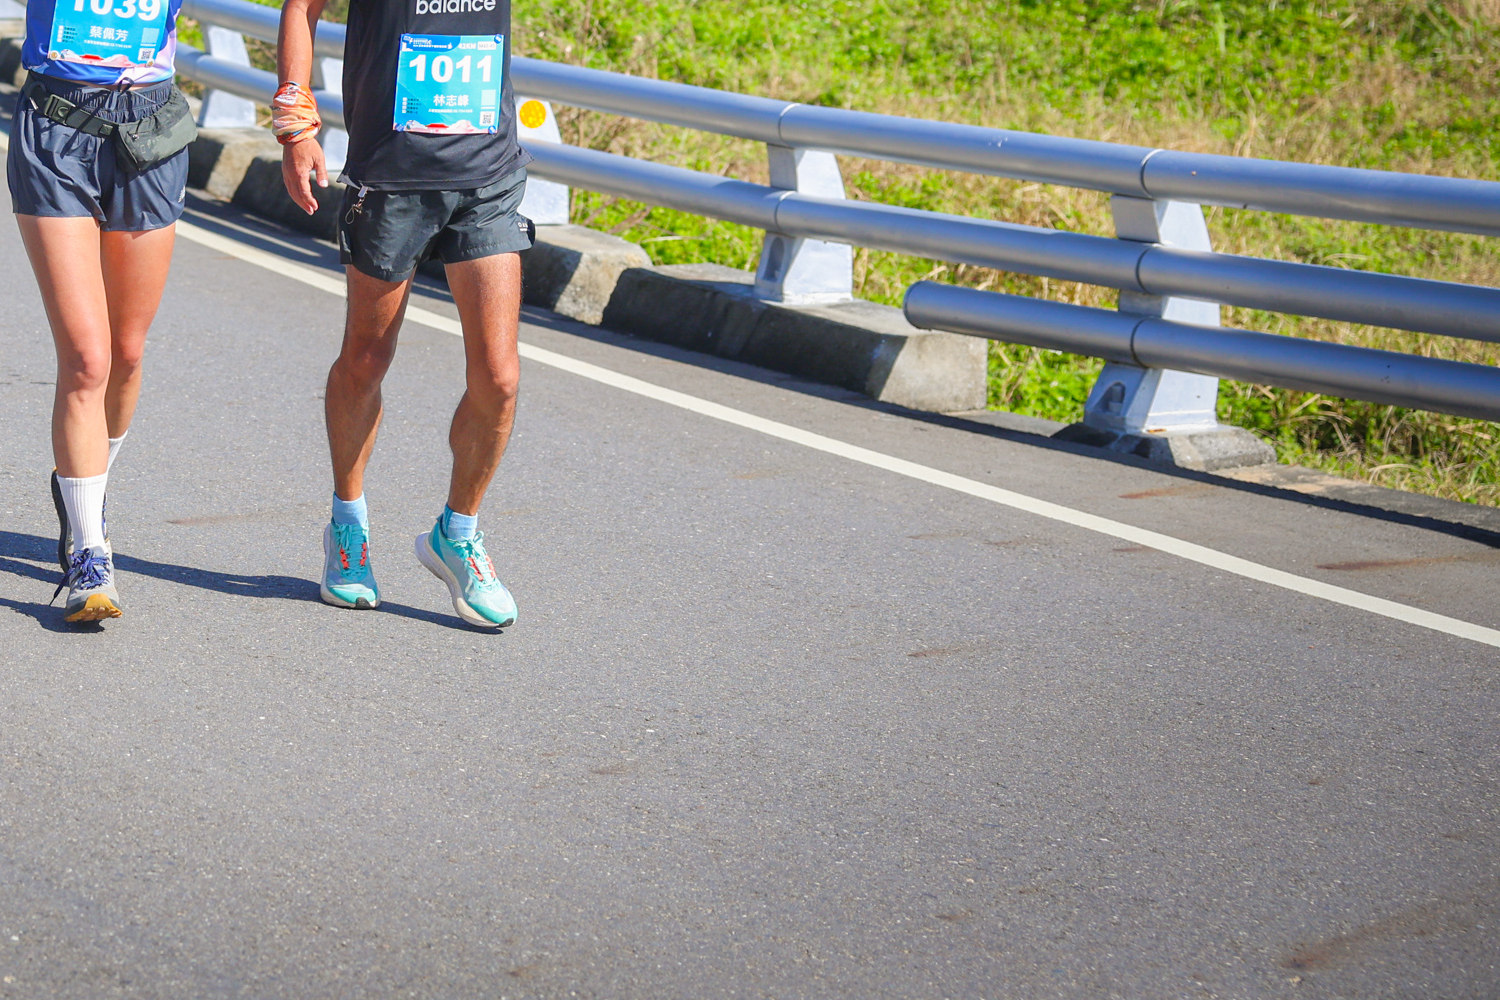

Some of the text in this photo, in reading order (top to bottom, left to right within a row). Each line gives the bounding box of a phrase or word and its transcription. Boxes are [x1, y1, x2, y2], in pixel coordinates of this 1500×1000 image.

[89, 25, 129, 42] 蔡佩芳
[408, 54, 492, 83] 1011
[433, 94, 469, 107] 林志峰
